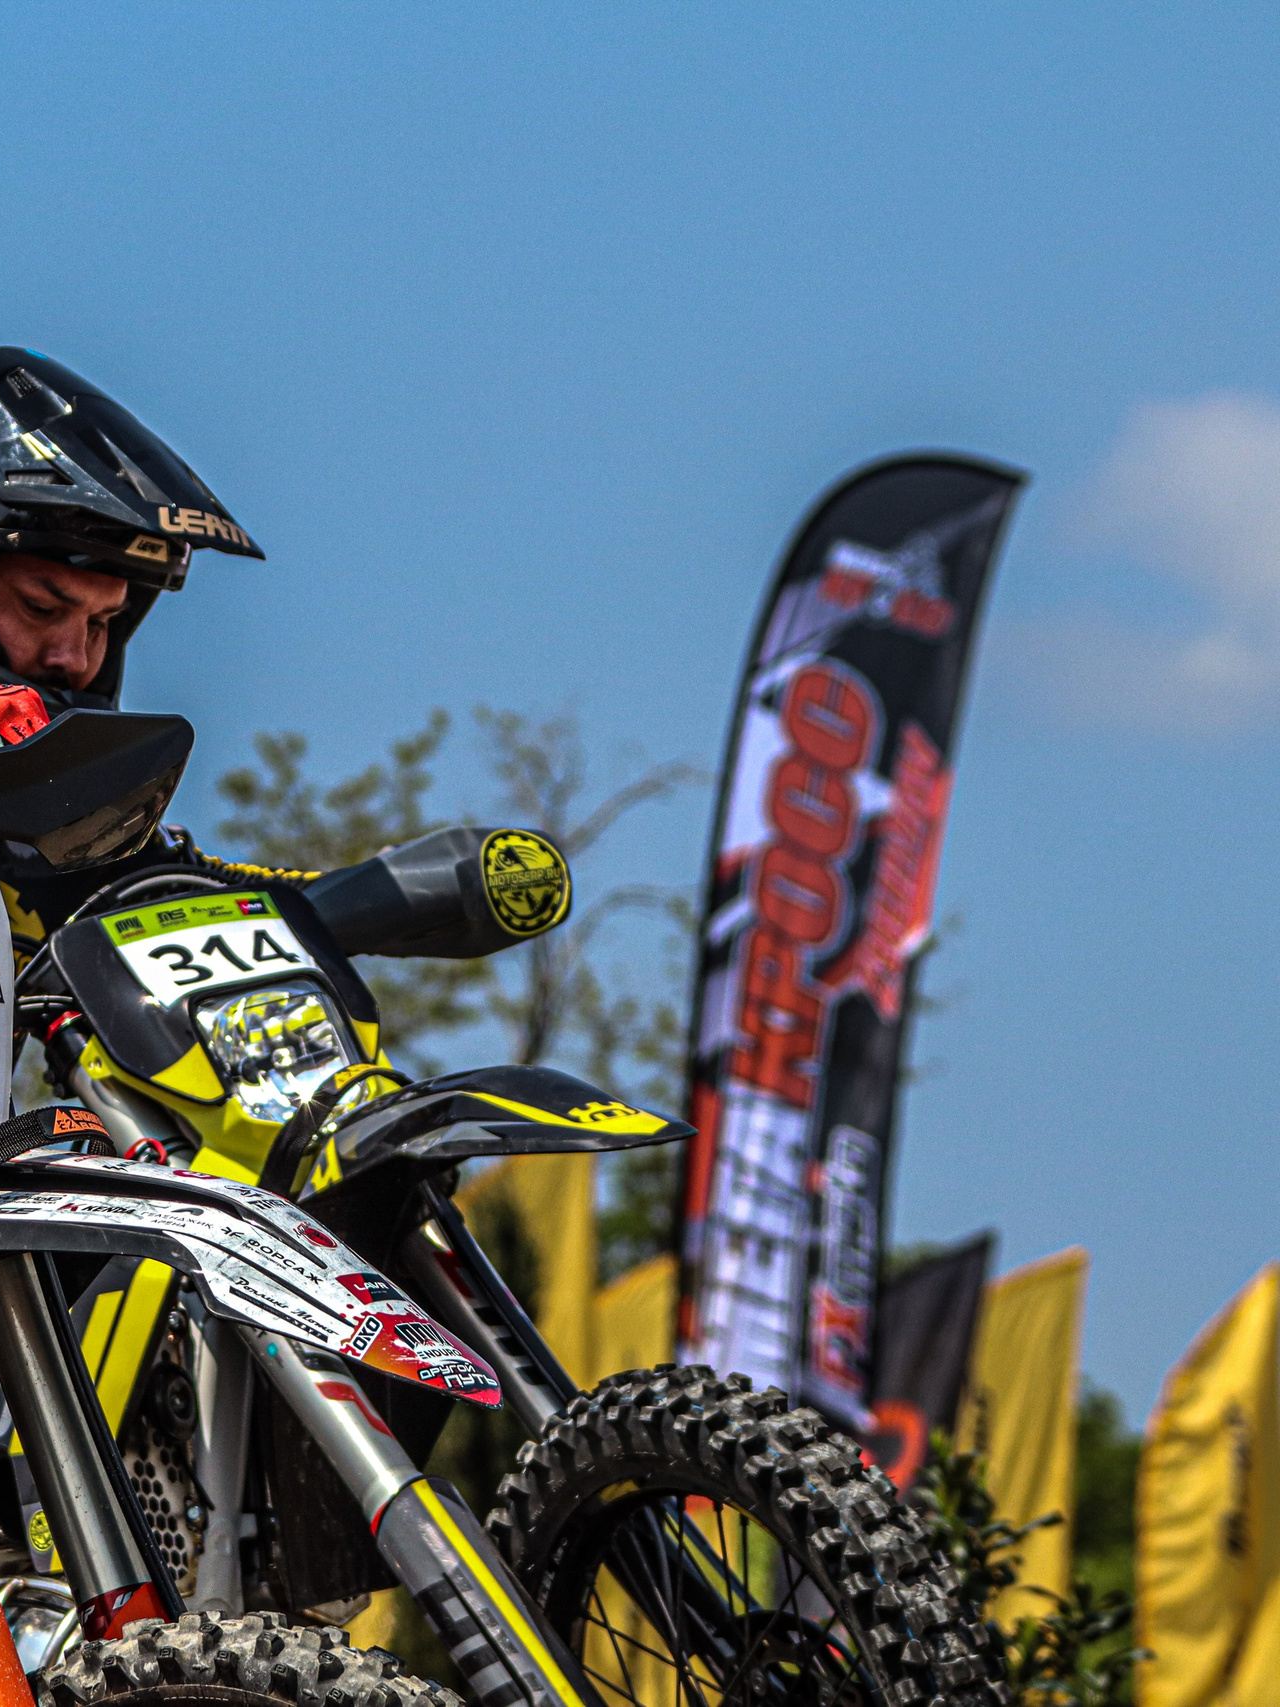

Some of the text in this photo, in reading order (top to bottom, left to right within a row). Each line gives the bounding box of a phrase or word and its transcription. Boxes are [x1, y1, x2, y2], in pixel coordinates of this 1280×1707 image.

[158, 506, 251, 548] LEATT
[148, 930, 301, 986] 314
[82, 1205, 138, 1215] KENDA
[247, 1238, 324, 1285] ФОРСАЖ
[353, 1281, 389, 1291] LAVR
[417, 1347, 463, 1360] ENDURO
[443, 1373, 499, 1388] ПУТЬ
